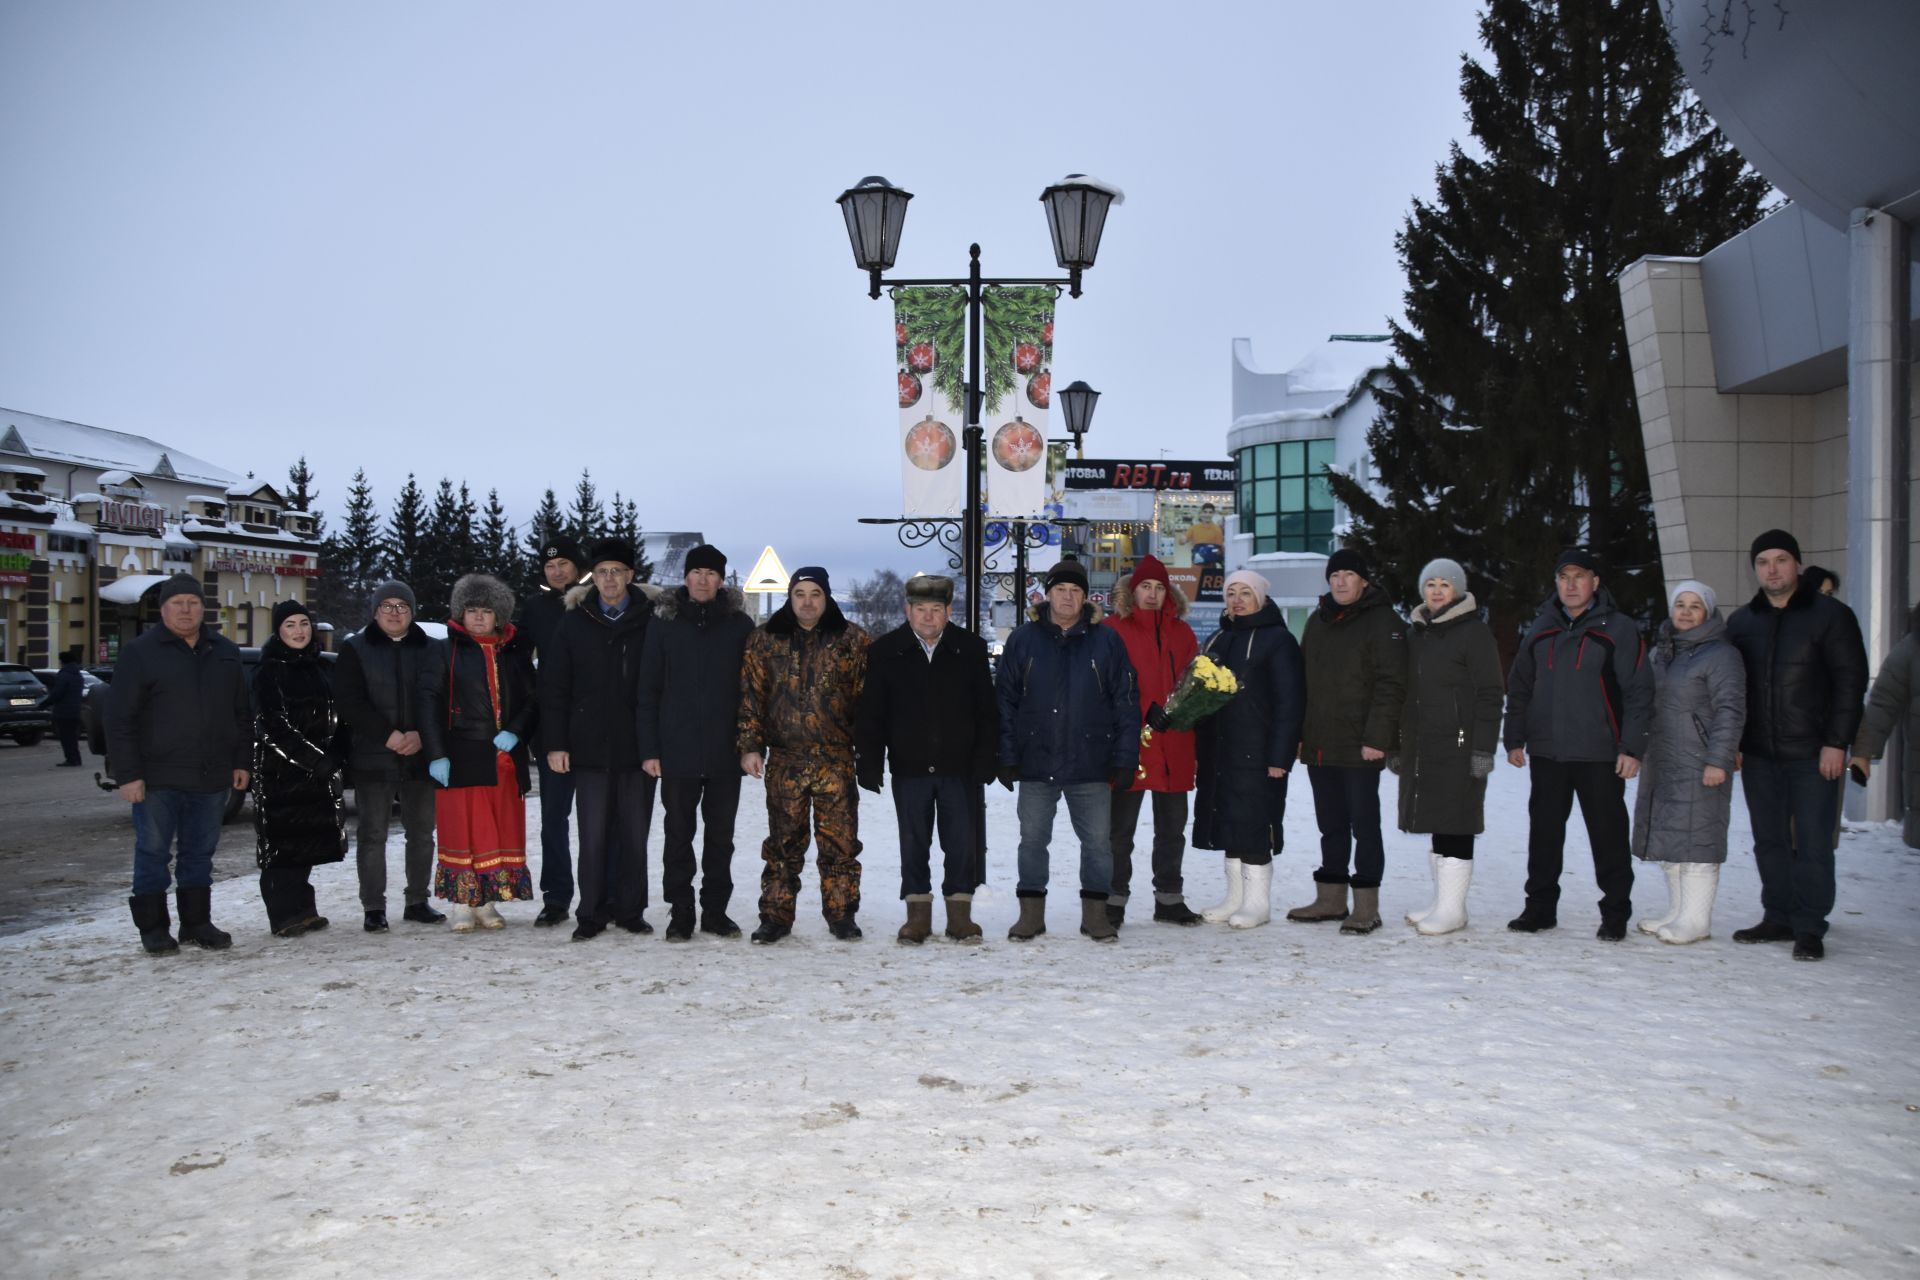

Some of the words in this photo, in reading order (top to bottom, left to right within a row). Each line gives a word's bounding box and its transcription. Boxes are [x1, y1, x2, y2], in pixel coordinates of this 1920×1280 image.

[1113, 463, 1193, 487] RBT.ru
[102, 501, 166, 533] КУПЕЦ
[1168, 574, 1197, 582] ОКОЛЬ
[1202, 575, 1224, 588] RB
